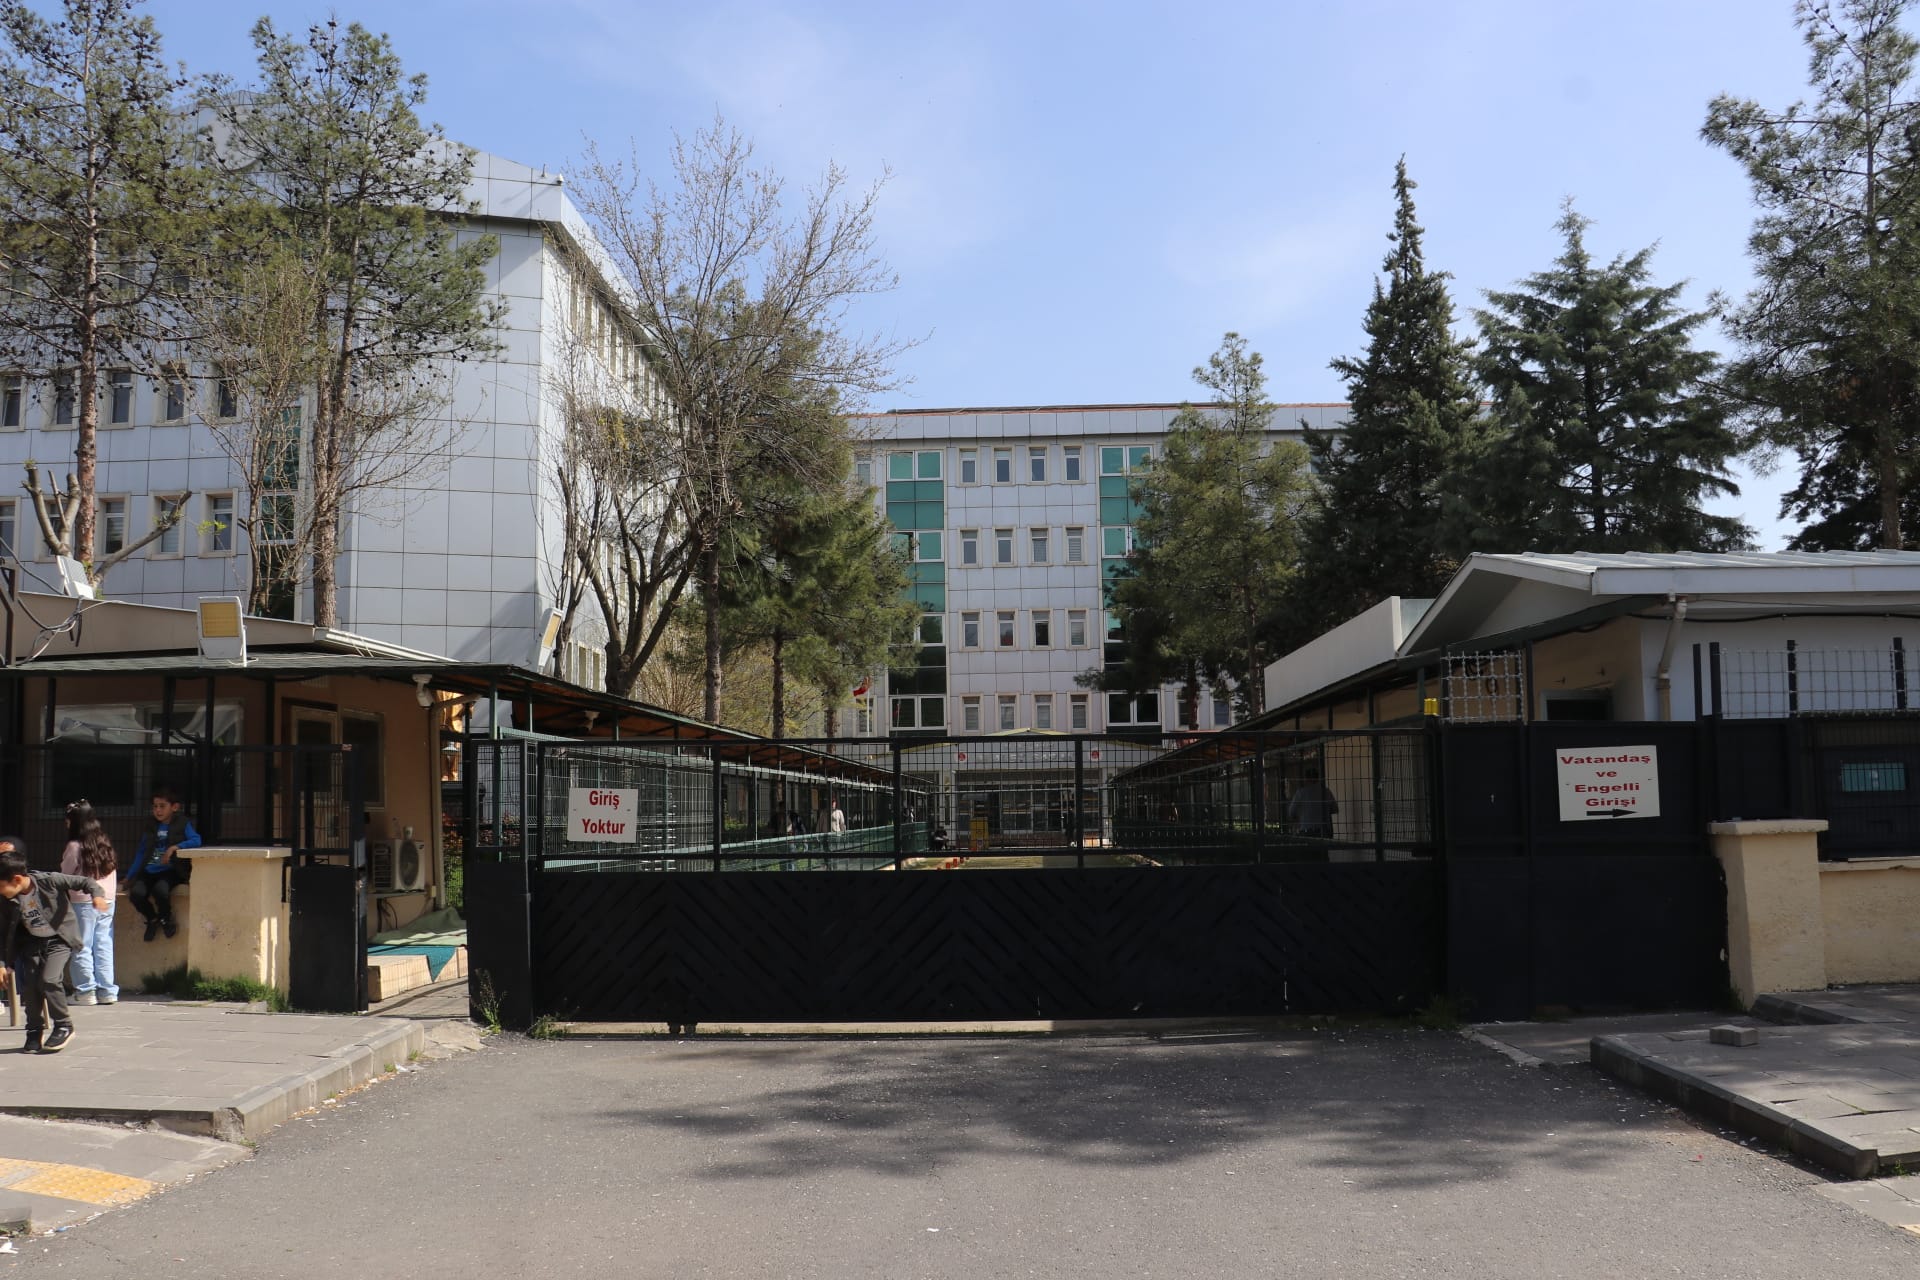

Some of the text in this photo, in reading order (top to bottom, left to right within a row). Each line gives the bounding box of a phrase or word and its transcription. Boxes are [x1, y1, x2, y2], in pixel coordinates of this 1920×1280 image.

[1560, 755, 1651, 764] Vatandaş
[1574, 783, 1640, 794] Engelli
[589, 790, 620, 810] Giriş
[1585, 797, 1636, 807] Girişi
[582, 818, 626, 834] Yoktur
